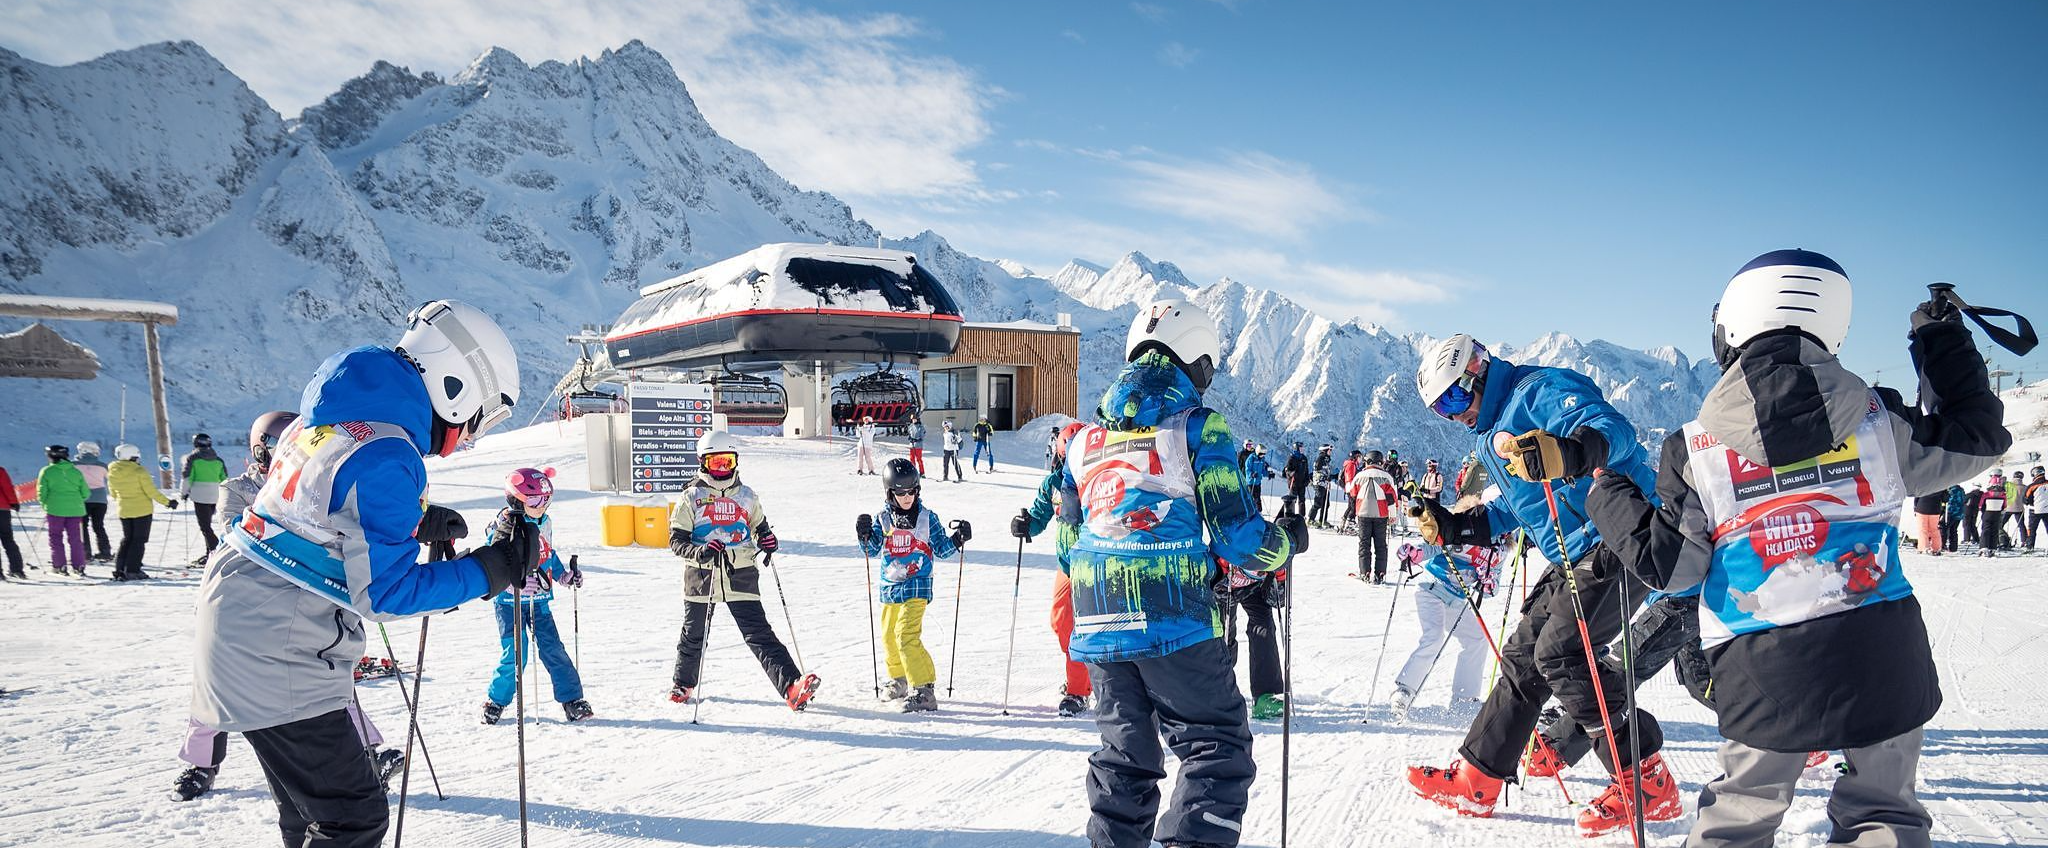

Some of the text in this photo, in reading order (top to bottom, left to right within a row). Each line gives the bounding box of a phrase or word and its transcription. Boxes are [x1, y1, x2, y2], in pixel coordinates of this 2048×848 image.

[659, 414, 685, 423] Alpe Alta
[633, 442, 659, 450] Paradiso
[663, 442, 686, 450] Presena
[1827, 465, 1855, 476] Völkl
[1781, 473, 1815, 485] DALBELLO
[1738, 482, 1772, 495] MARKER
[714, 502, 736, 514] WILD
[1762, 511, 1815, 541] WILD
[892, 534, 911, 547] WILD
[1093, 538, 1194, 551] www.wildholidays.pl
[1765, 535, 1817, 557] HOLIDAYS
